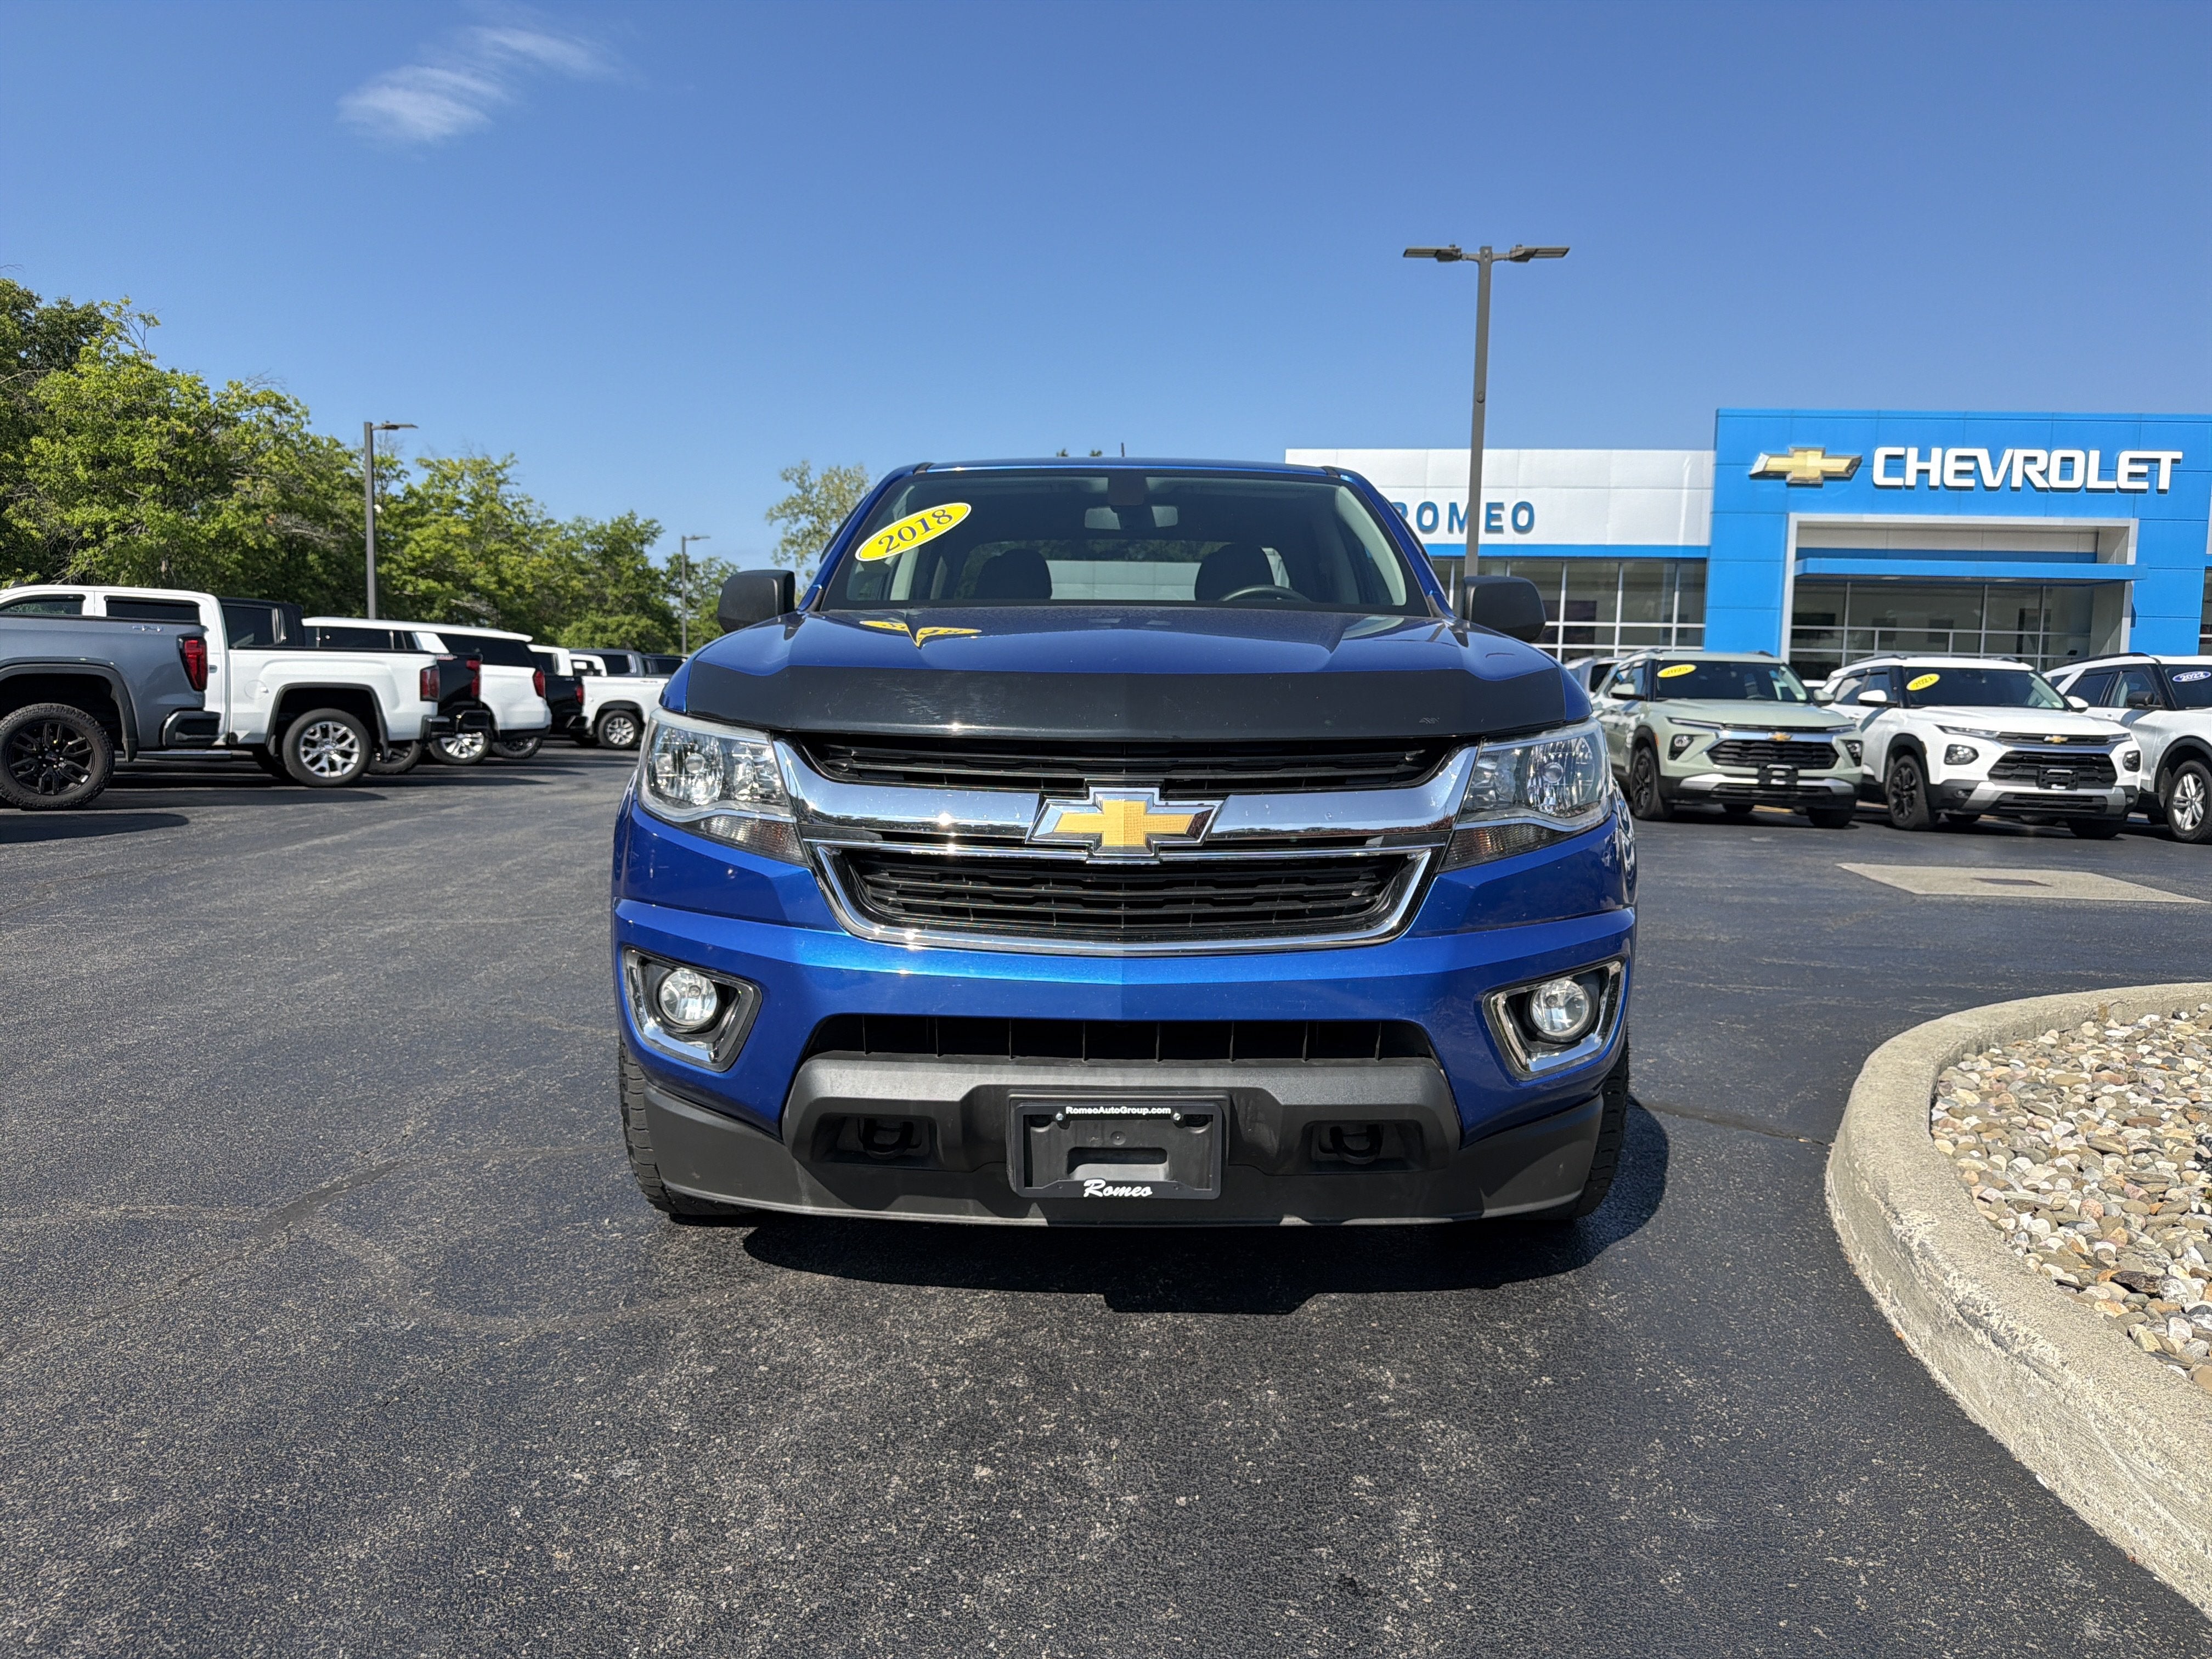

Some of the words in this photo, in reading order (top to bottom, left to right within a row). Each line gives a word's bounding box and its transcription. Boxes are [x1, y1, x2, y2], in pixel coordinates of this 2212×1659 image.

[1872, 447, 2183, 493] CHEVROLET
[878, 509, 952, 553] 2018
[2179, 672, 2205, 681] 2022
[1065, 1106, 1171, 1115] RomeoAutoGroup.com
[1083, 1178, 1153, 1197] Romeo
